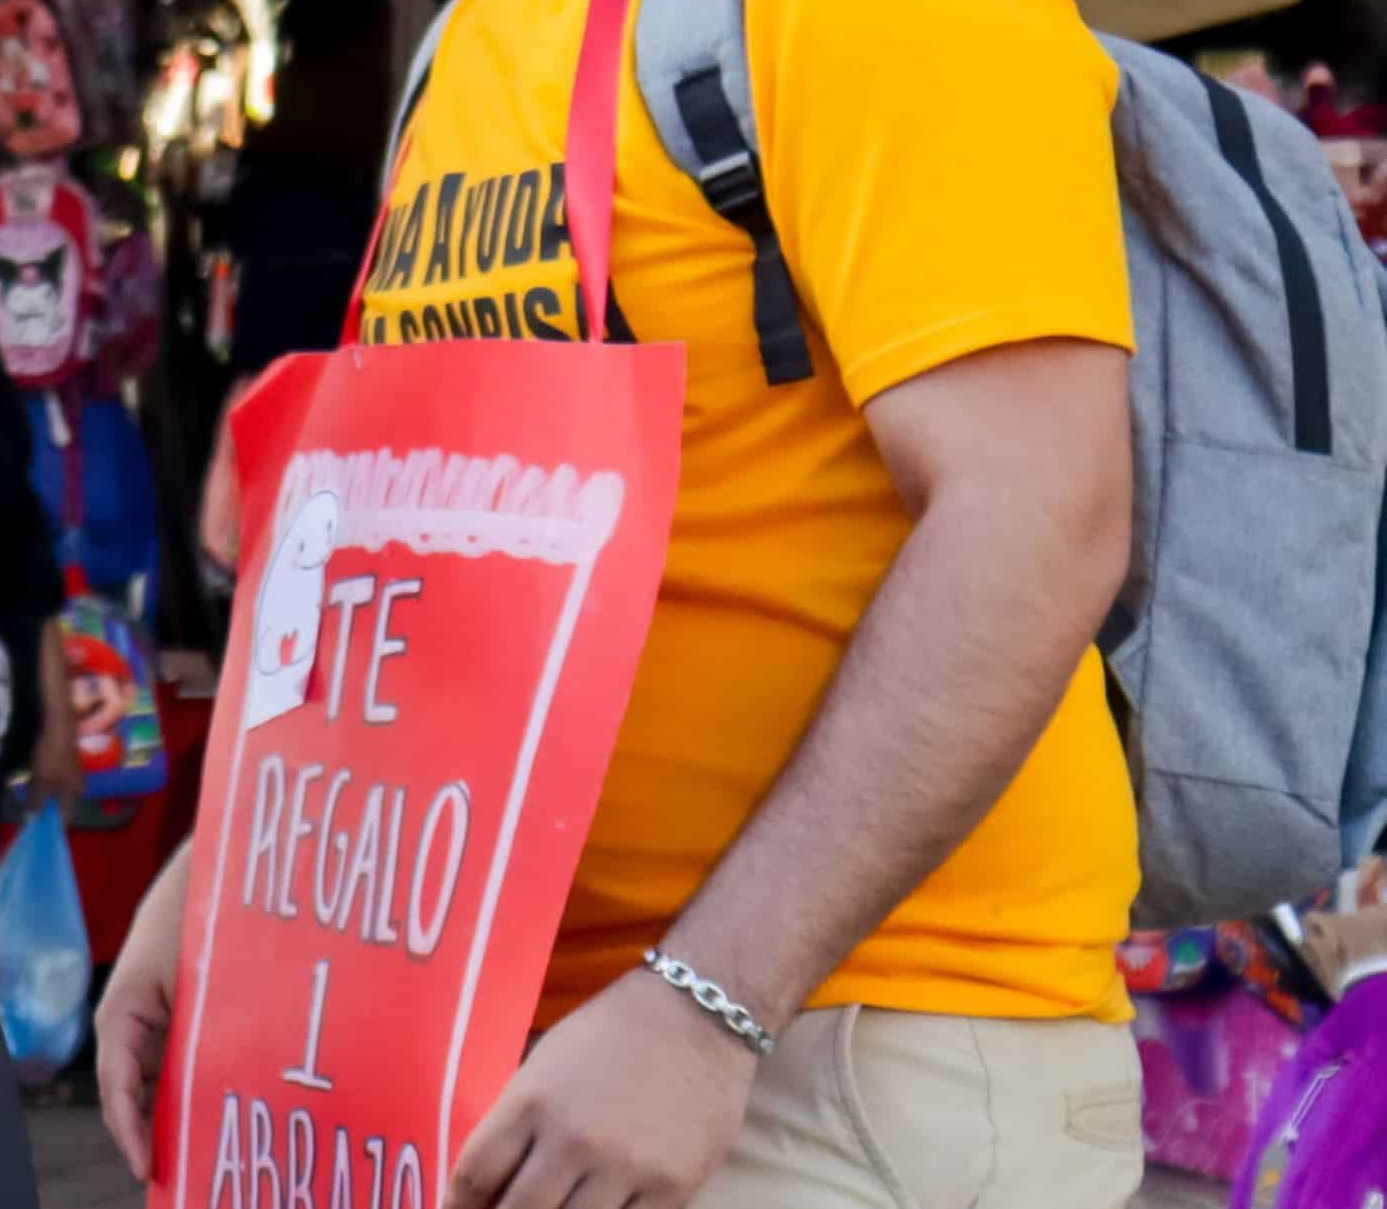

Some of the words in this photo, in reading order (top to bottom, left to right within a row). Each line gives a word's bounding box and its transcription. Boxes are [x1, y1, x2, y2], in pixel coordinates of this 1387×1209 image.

[422, 162, 573, 288] AYUDA
[326, 573, 424, 725] TE
[242, 752, 472, 960] REGALO
